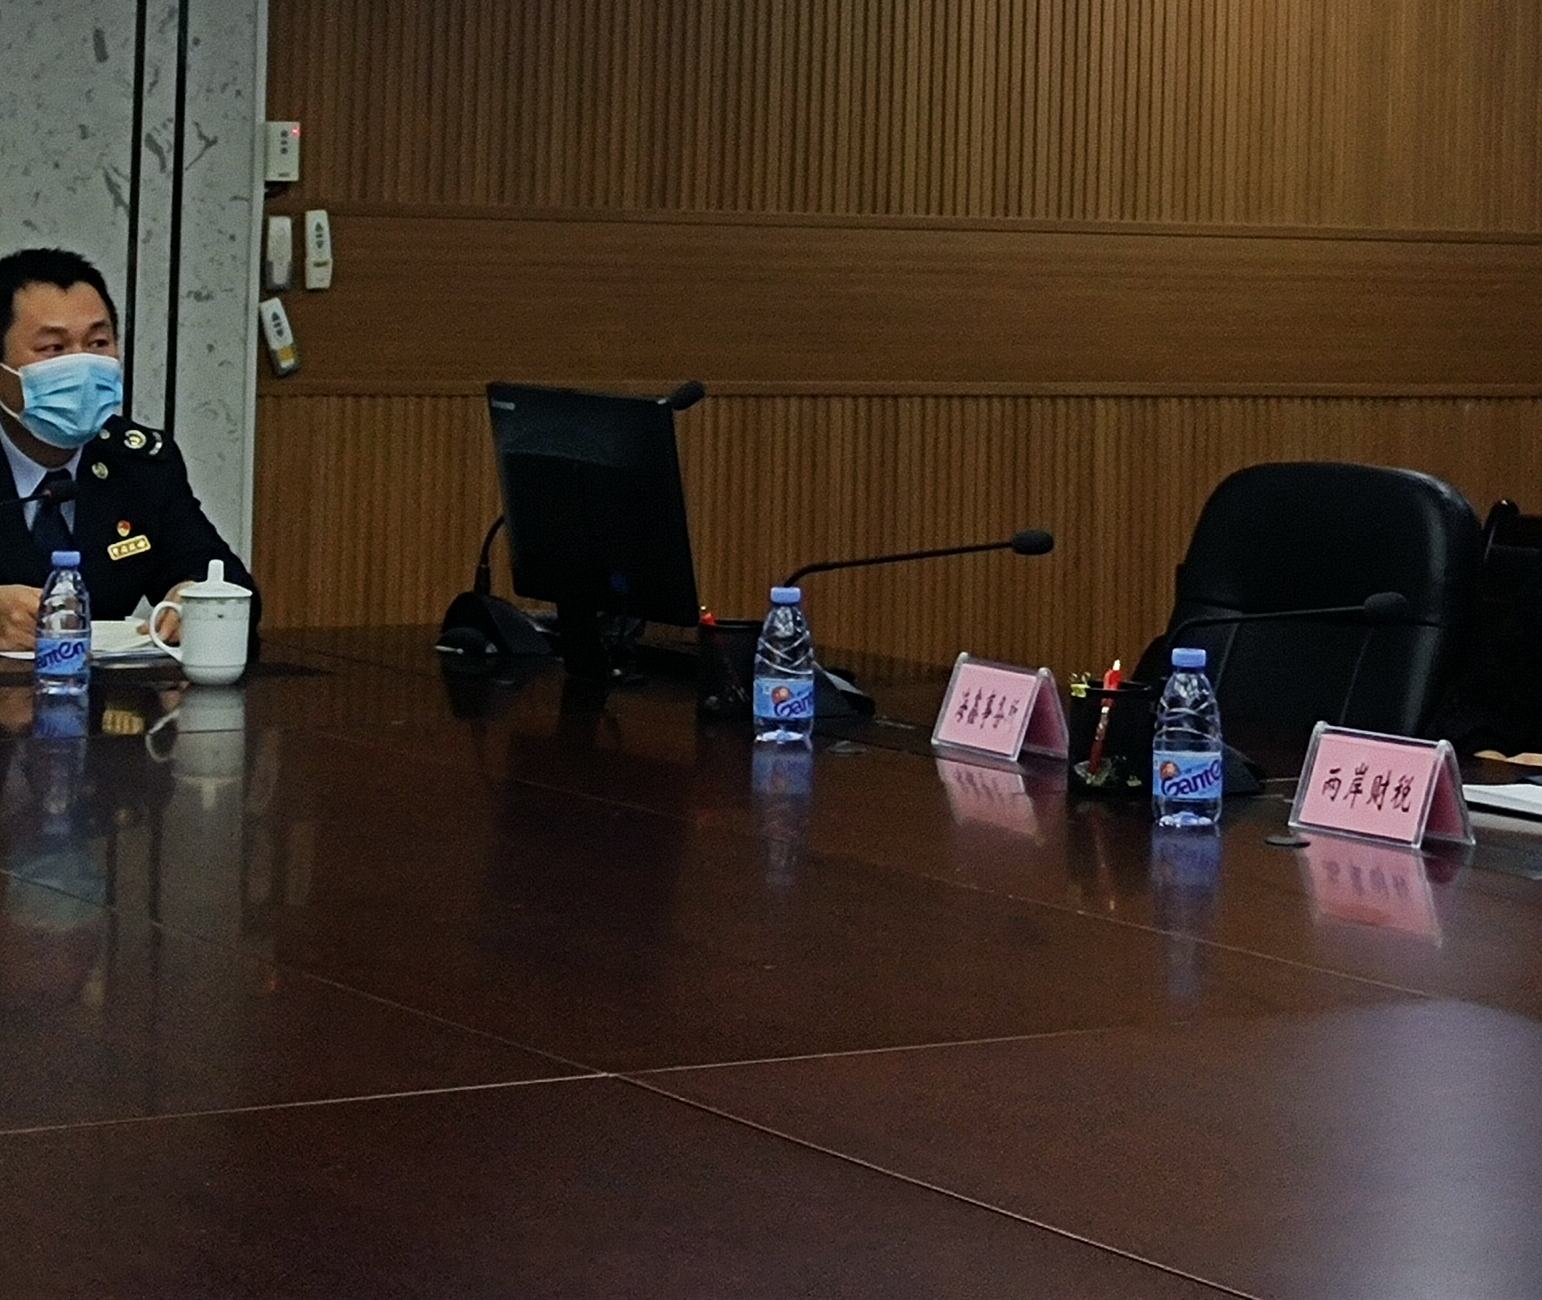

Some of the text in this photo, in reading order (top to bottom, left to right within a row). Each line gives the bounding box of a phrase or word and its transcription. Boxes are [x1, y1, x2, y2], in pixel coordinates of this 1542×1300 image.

[1161, 759, 1222, 797] Gante
[1321, 762, 1415, 813] 两岸财税
